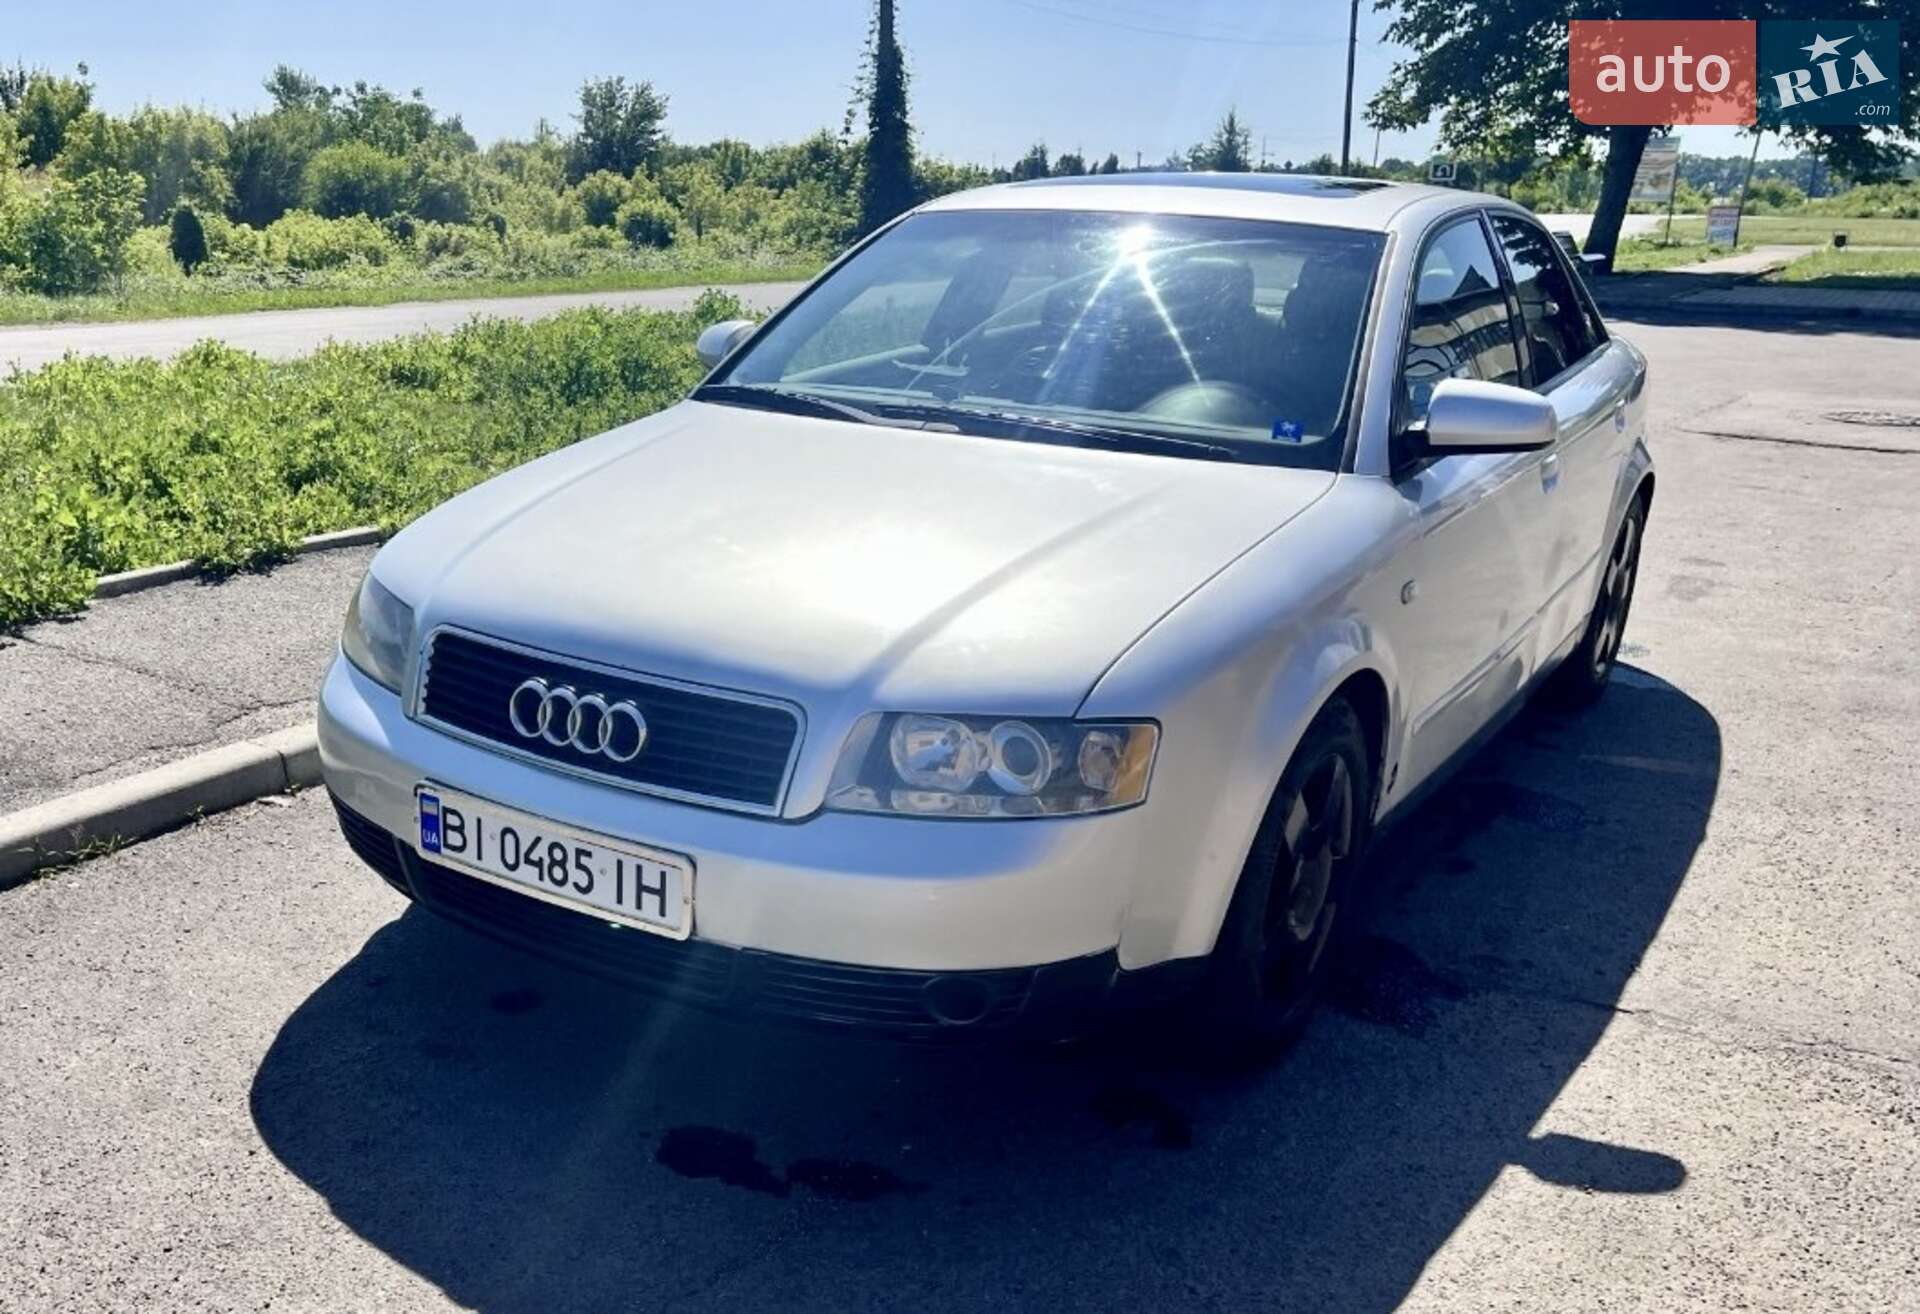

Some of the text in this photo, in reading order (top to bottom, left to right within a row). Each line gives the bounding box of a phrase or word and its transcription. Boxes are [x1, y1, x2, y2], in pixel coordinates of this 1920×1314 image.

[423, 828, 439, 845] UA
[442, 806, 667, 917] BI 0485 IH
